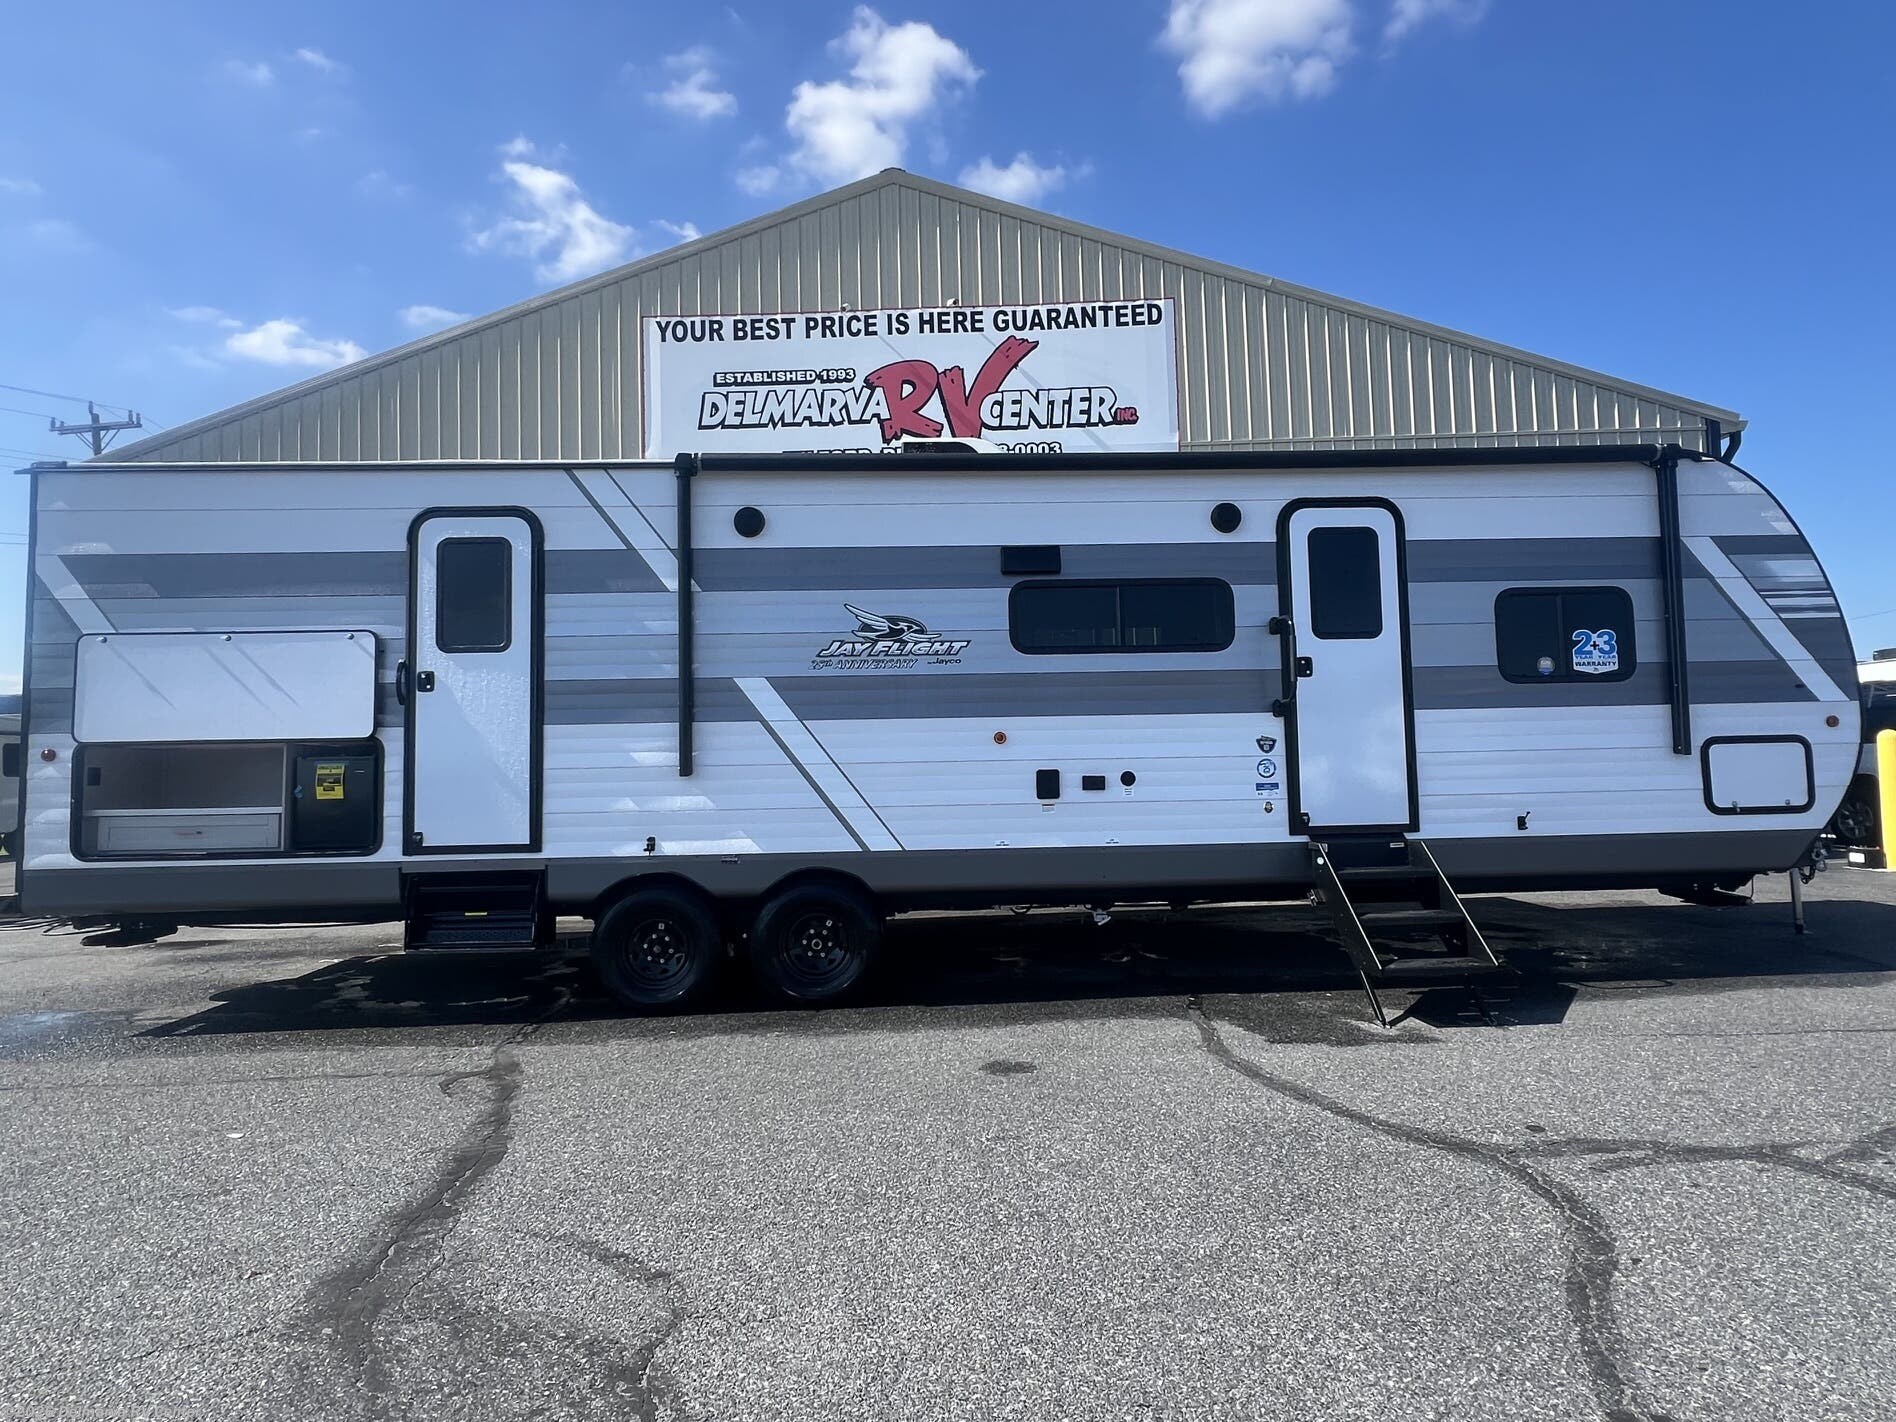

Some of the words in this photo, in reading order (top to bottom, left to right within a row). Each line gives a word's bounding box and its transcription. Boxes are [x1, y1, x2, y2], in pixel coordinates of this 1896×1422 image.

[655, 318, 724, 343] YOUR
[733, 317, 796, 341] BEST
[805, 314, 878, 339] PRICE
[887, 313, 910, 336] IS
[919, 310, 984, 334] HERE
[993, 303, 1162, 332] GUARANTEED
[714, 370, 817, 386] ESTABLISHED
[819, 368, 856, 382] 1993
[698, 386, 892, 430] DELMARVA
[864, 335, 1039, 444] RV
[979, 386, 1117, 430] CENTER
[816, 639, 872, 657] JAY
[868, 639, 972, 657] FLIGHT
[1573, 630, 1617, 655] 2+3
[808, 658, 833, 671] 25th
[834, 658, 918, 670] ANNIVERSARY
[934, 657, 962, 666] Jayco
